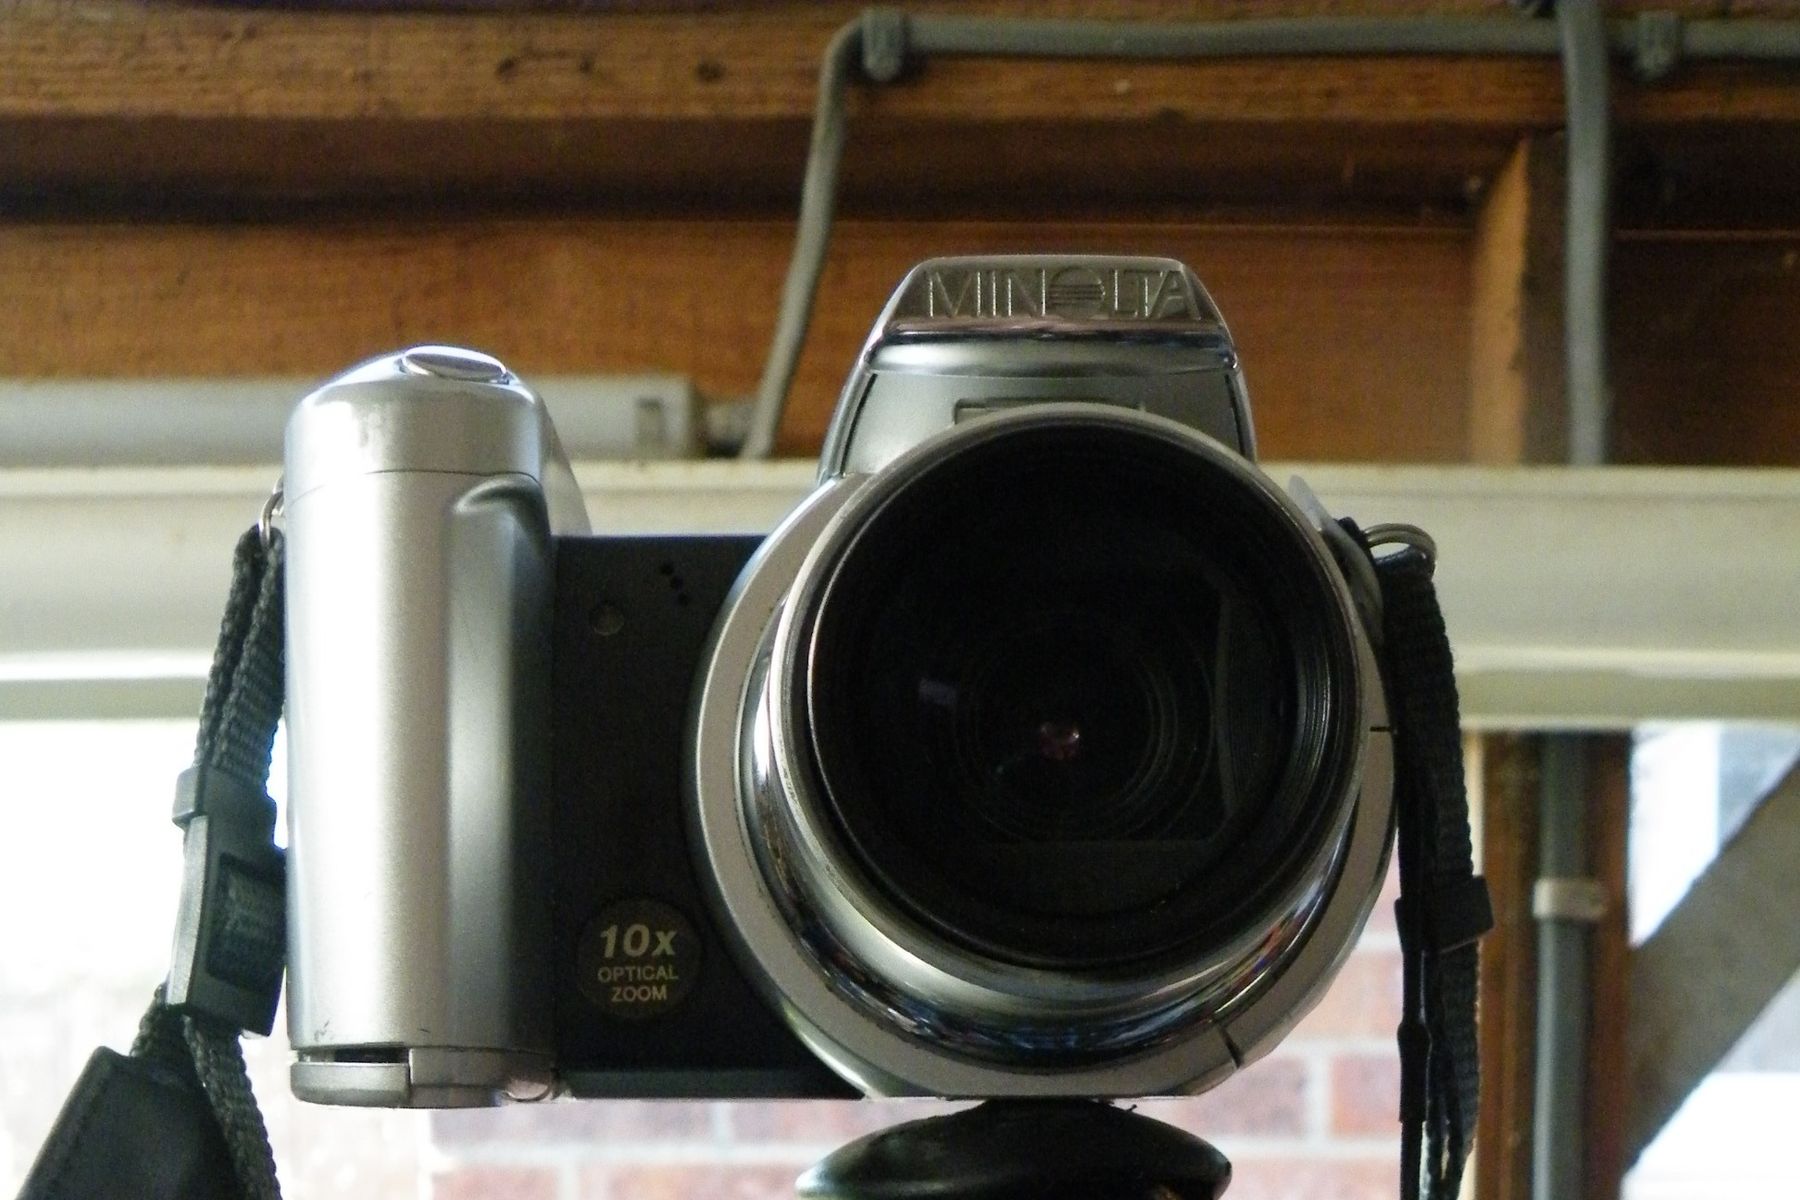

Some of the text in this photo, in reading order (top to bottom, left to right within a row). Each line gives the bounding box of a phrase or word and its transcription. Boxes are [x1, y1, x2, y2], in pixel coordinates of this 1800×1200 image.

[925, 266, 1202, 321] MINOLTA
[600, 923, 677, 959] 10x
[597, 964, 680, 983] OPTICAL
[611, 984, 668, 1003] ZOOM
